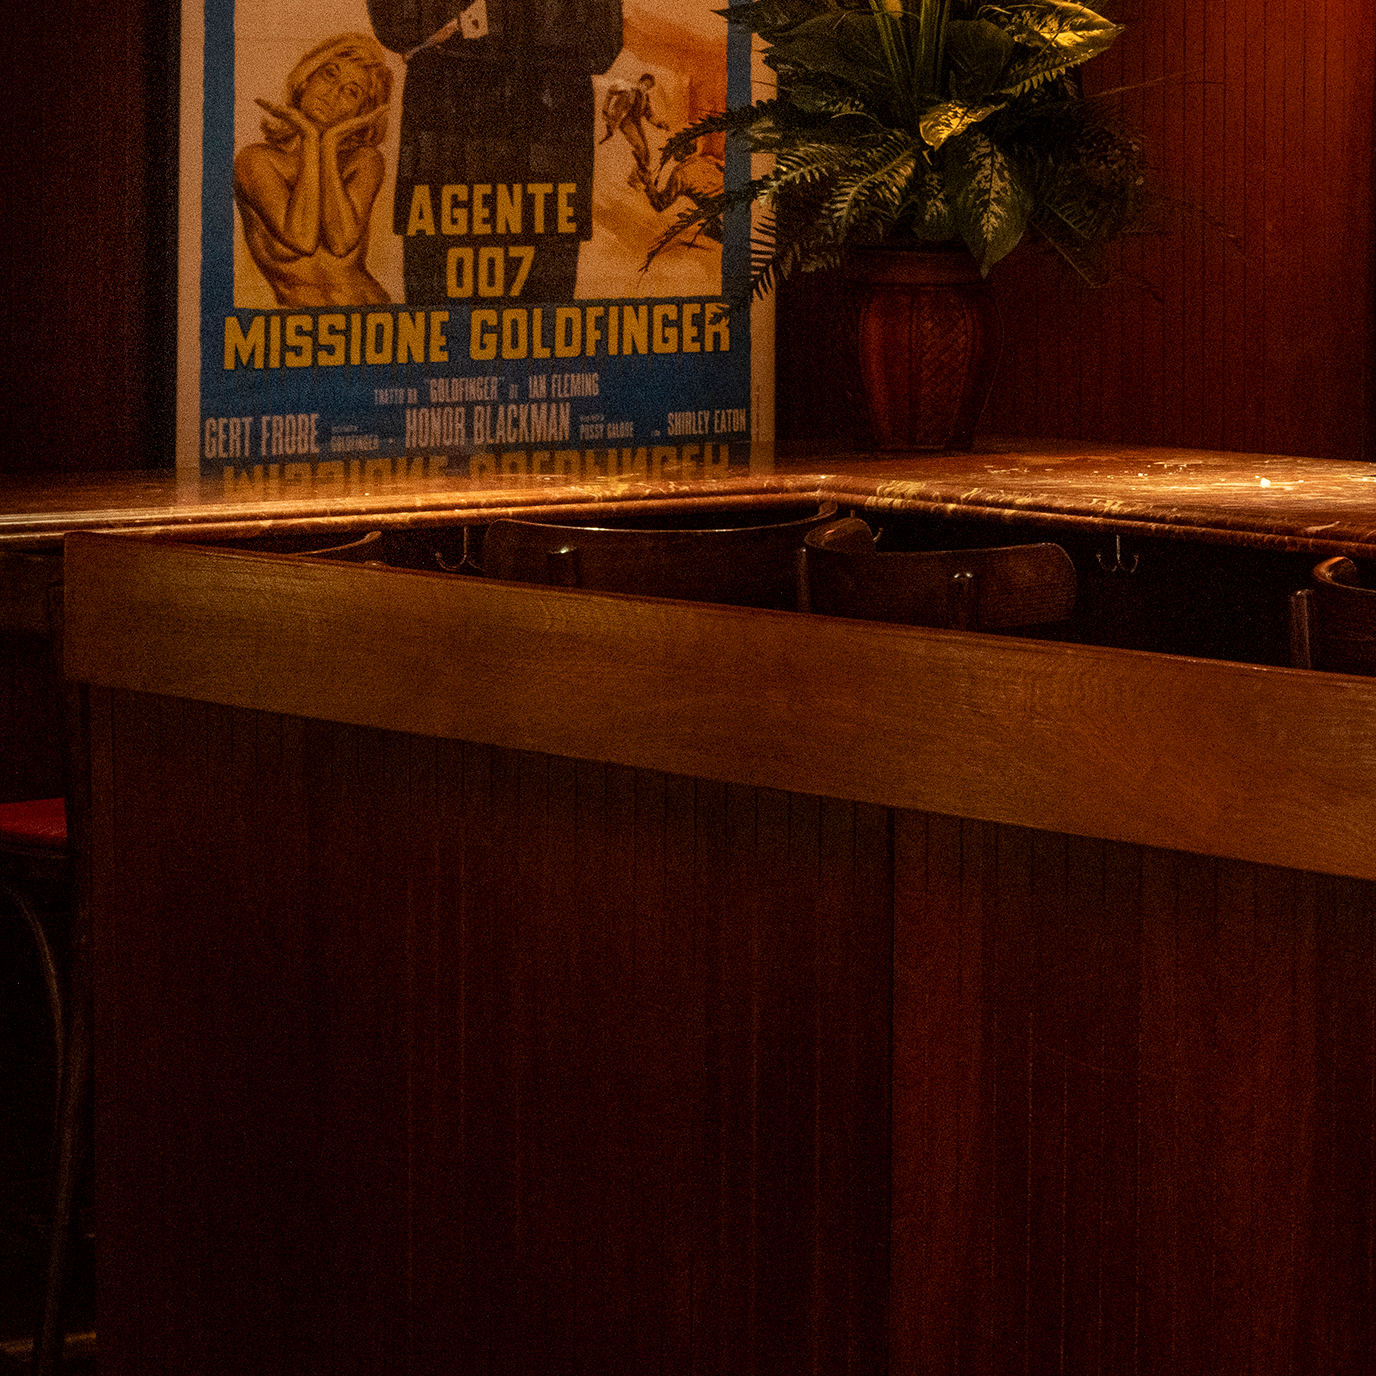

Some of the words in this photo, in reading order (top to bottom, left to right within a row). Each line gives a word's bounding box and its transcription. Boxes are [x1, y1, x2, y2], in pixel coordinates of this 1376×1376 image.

[407, 182, 578, 237] AGENTE
[446, 245, 536, 299] 007
[223, 311, 450, 370] MISSIONE
[469, 302, 731, 361] GOLDFINGER
[528, 375, 547, 399] IAN
[551, 372, 600, 398] FLEMING
[204, 416, 253, 460] GERT
[405, 406, 467, 449] HONOR
[473, 402, 571, 446] BLACKMAN
[667, 410, 710, 437] SHIRLEY
[713, 408, 747, 434] EATON
